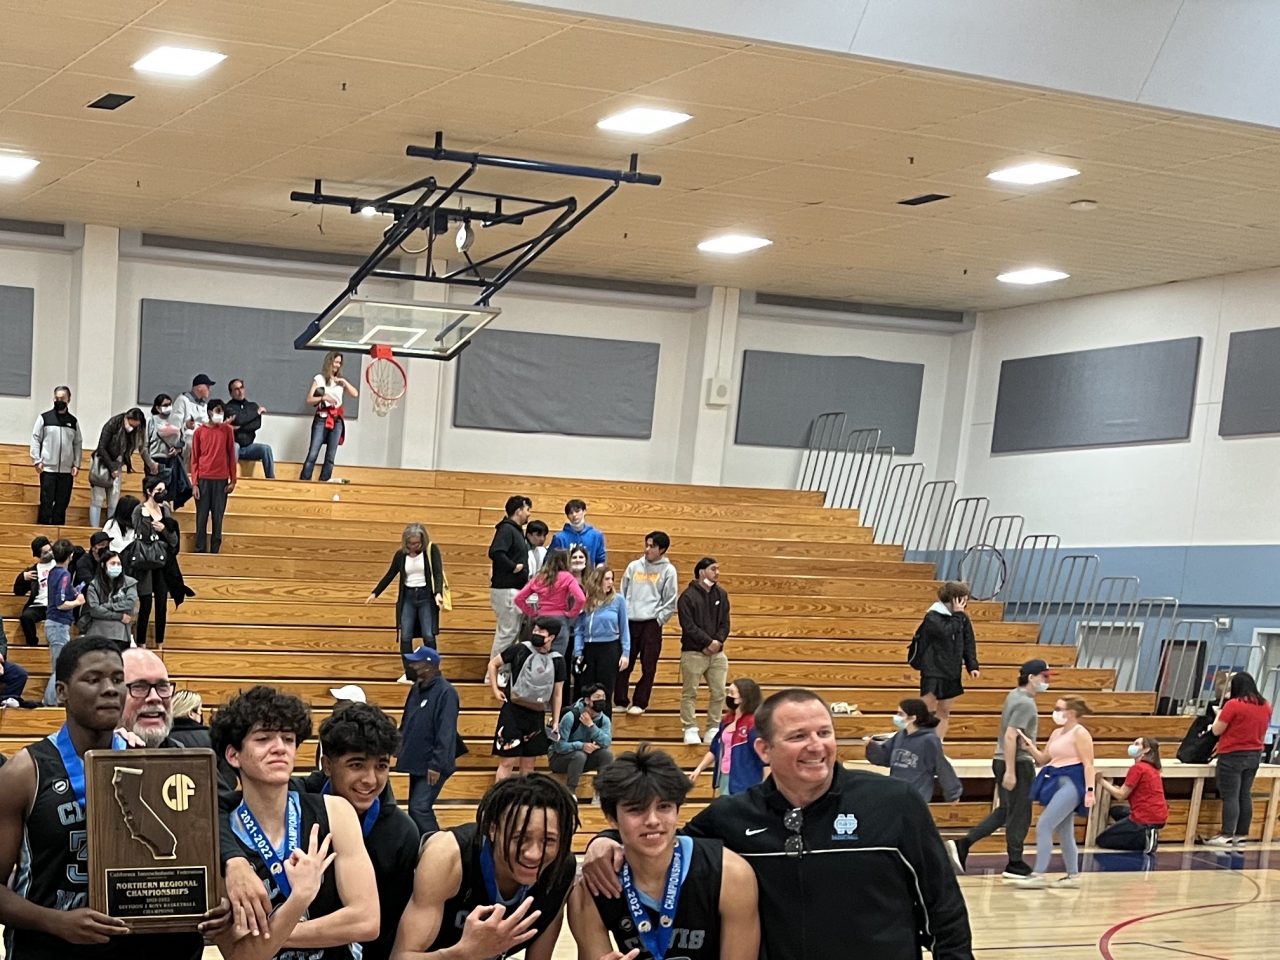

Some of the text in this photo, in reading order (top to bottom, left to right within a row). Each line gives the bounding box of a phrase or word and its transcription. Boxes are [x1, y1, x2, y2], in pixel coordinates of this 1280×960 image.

[161, 773, 196, 812] CIF
[239, 809, 274, 862] 2021-2022
[116, 880, 198, 890] NORTHERN REGIONAL
[126, 888, 189, 897] CHAMPIONSHIPS
